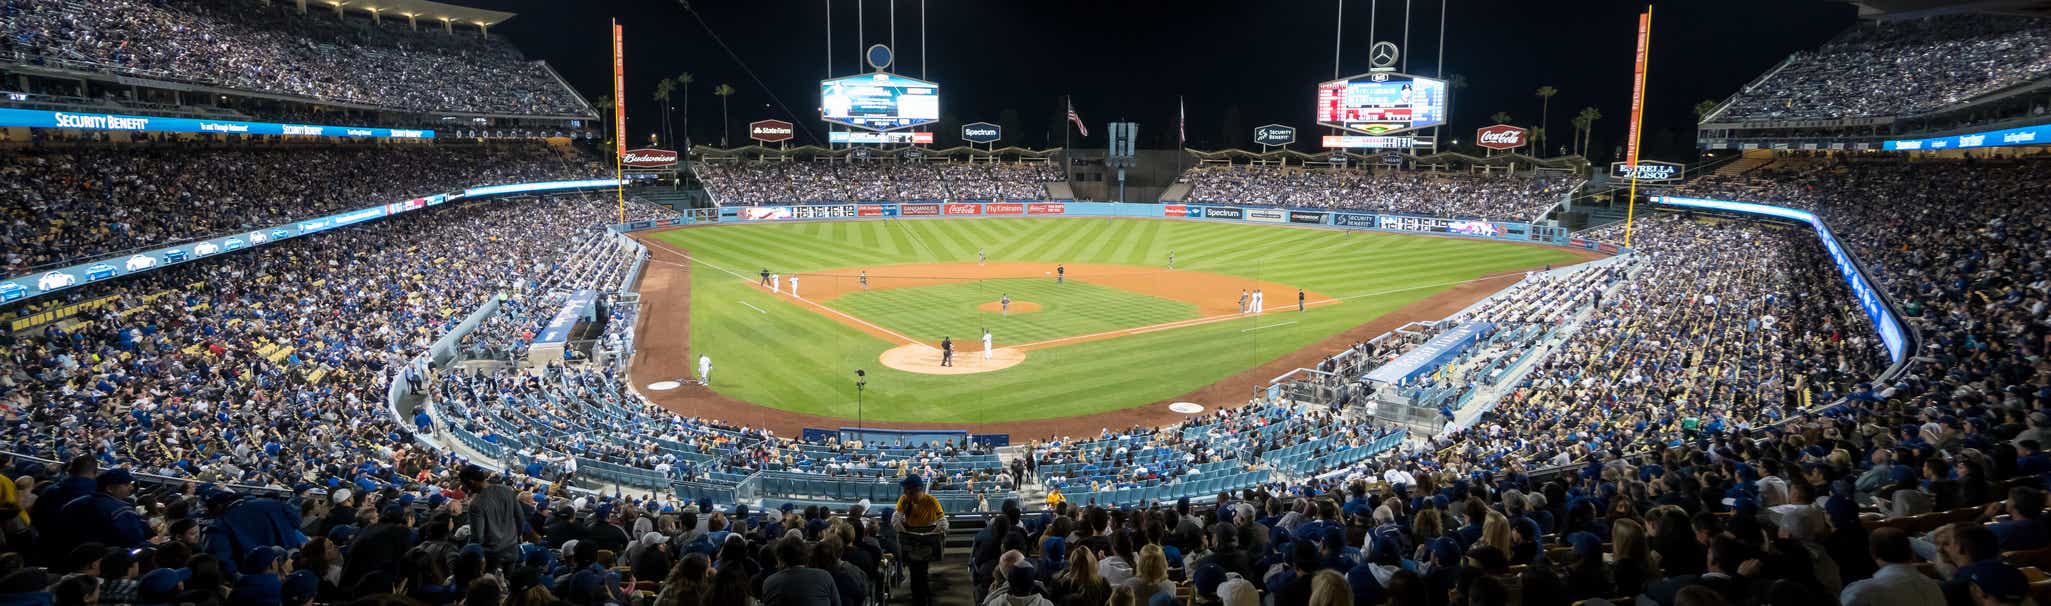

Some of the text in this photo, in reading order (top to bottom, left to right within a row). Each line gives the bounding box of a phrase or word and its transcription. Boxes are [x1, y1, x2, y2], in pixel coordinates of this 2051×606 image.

[55, 112, 106, 128] SECURITY
[1480, 130, 1521, 144] Coca-Cola
[623, 153, 675, 163] Budweiser
[1207, 208, 1239, 217] Spectrum
